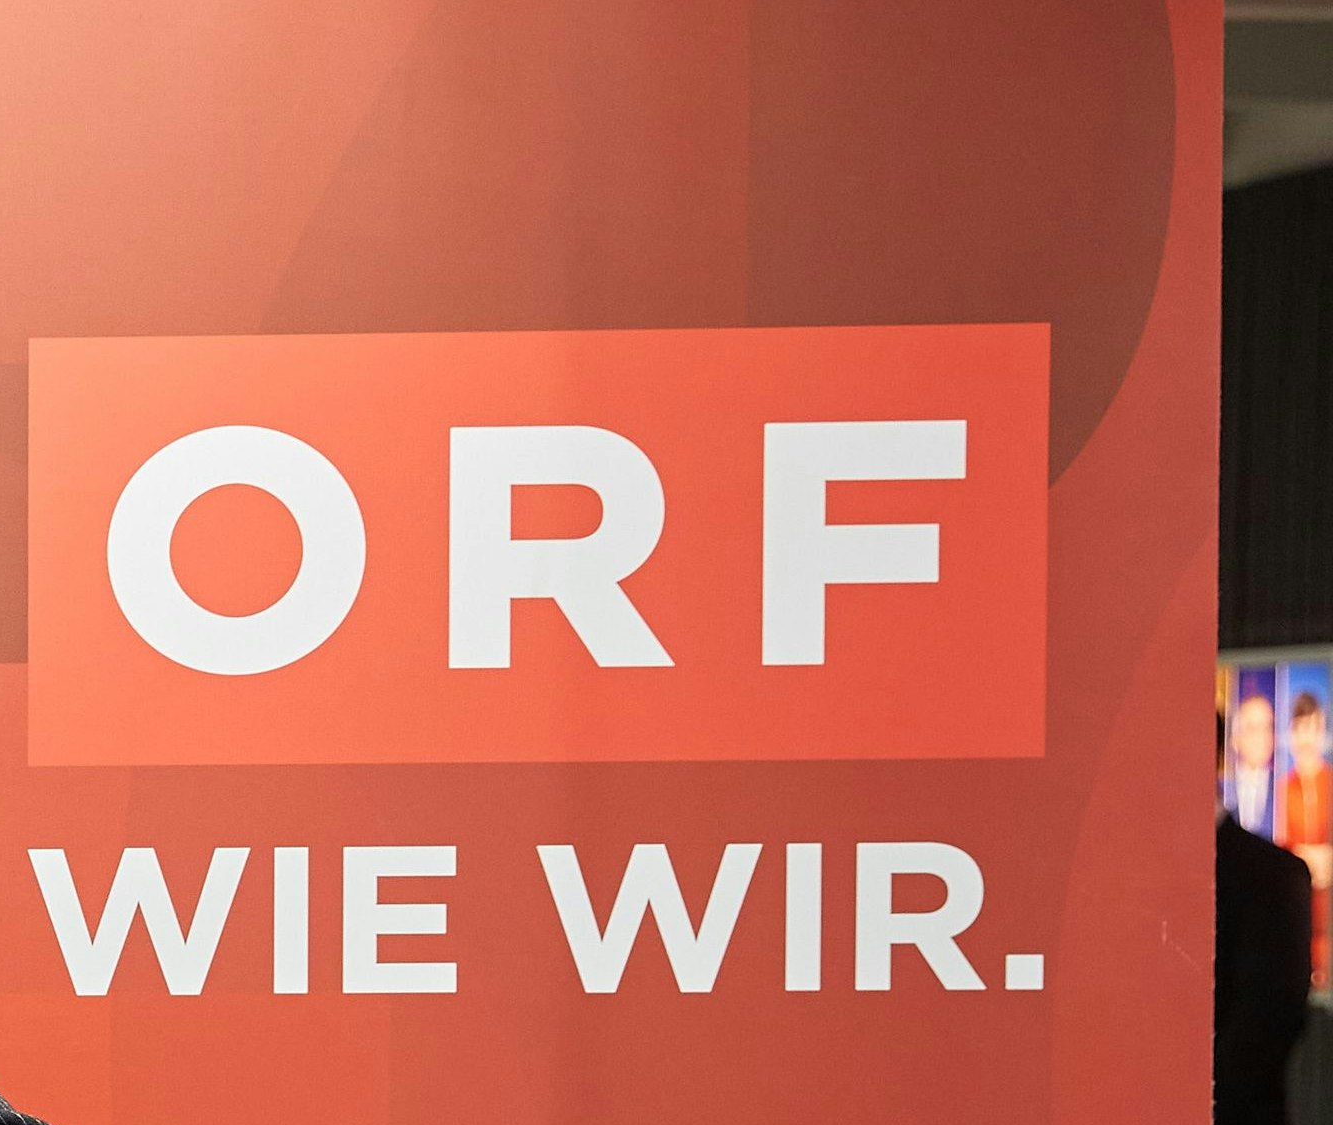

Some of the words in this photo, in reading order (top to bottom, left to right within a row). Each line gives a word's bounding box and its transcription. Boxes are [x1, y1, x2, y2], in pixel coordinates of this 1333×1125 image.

[106, 420, 968, 675] ORF
[28, 846, 458, 996] WIE
[536, 842, 1045, 993] WIR.
